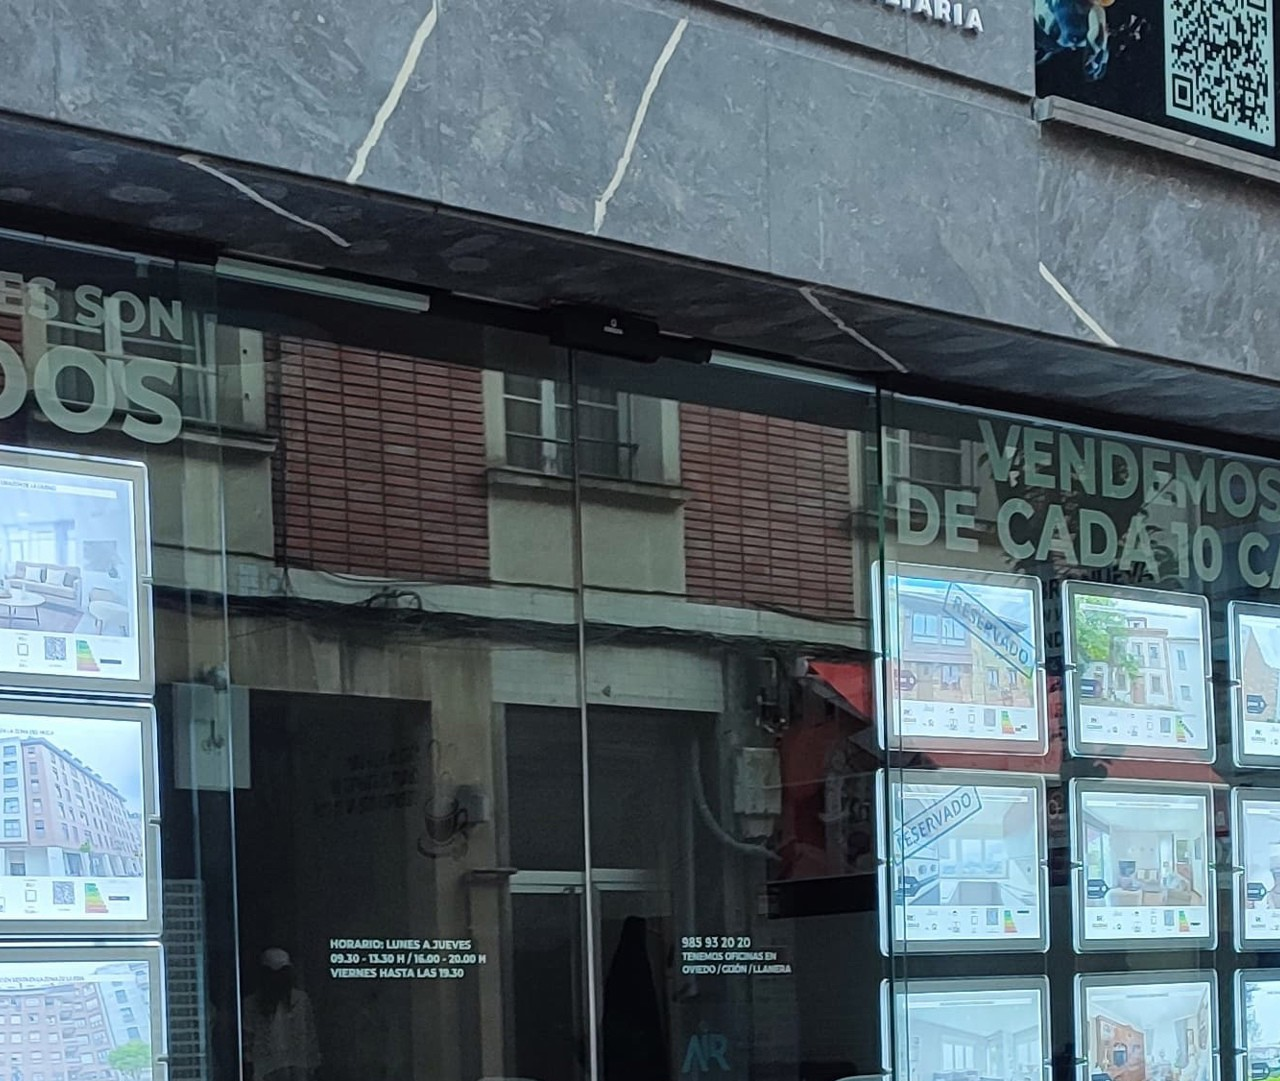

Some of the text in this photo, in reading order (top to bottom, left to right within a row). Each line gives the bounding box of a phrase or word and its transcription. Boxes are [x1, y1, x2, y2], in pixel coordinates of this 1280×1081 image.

[74, 284, 185, 342] SON
[895, 483, 978, 553] DE
[997, 497, 1159, 582] CADA
[1172, 523, 1222, 582] 10
[952, 596, 1028, 664] RESERVADO
[330, 939, 471, 950] HORARIO: LUNES A JUEVES
[681, 936, 751, 948] 985 93 20 20
[330, 954, 360, 964] 09.30
[397, 954, 405, 964] H
[448, 954, 476, 964] 20.00
[478, 954, 487, 964] H
[682, 952, 777, 961] TENEMOS OFICINAS EN
[331, 968, 464, 978] VIERNES HASTA LAS 19.30
[682, 965, 716, 974] OVIEDO
